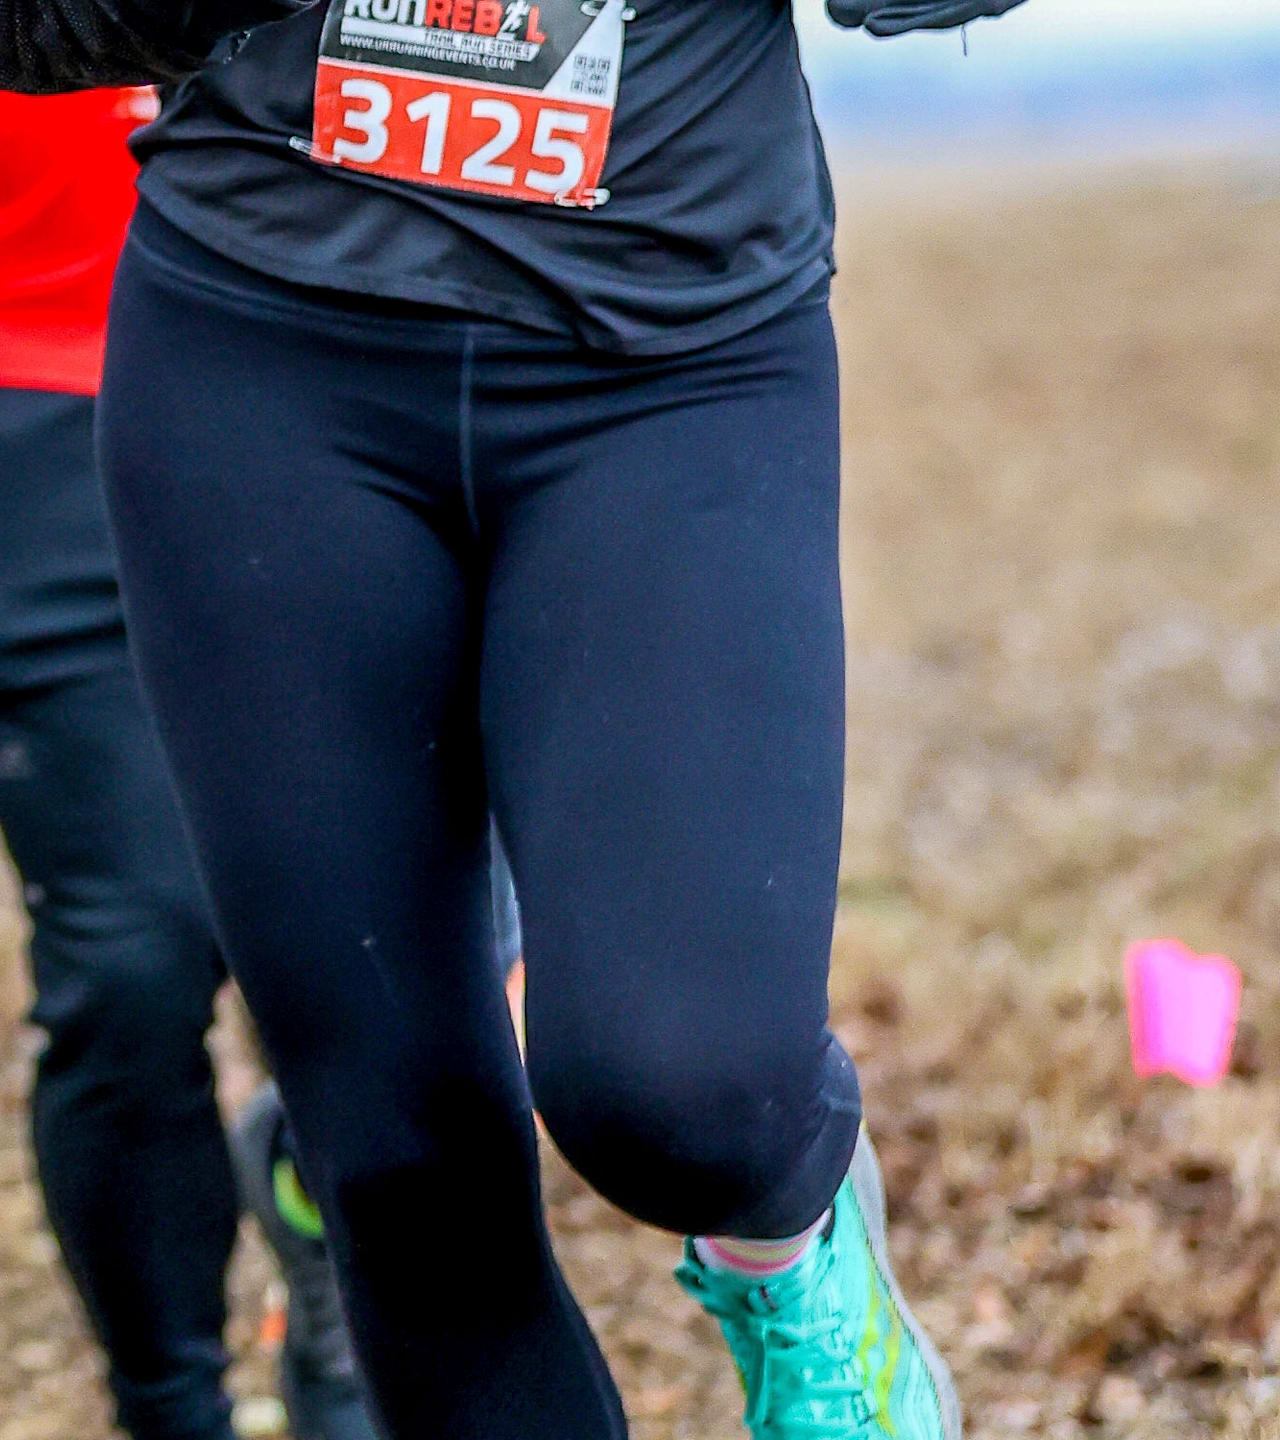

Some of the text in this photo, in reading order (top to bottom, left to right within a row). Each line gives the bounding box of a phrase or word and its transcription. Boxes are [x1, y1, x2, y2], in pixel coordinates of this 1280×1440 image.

[424, 33, 530, 60] TRAIL RUN SERIES
[332, 78, 590, 194] 3125
